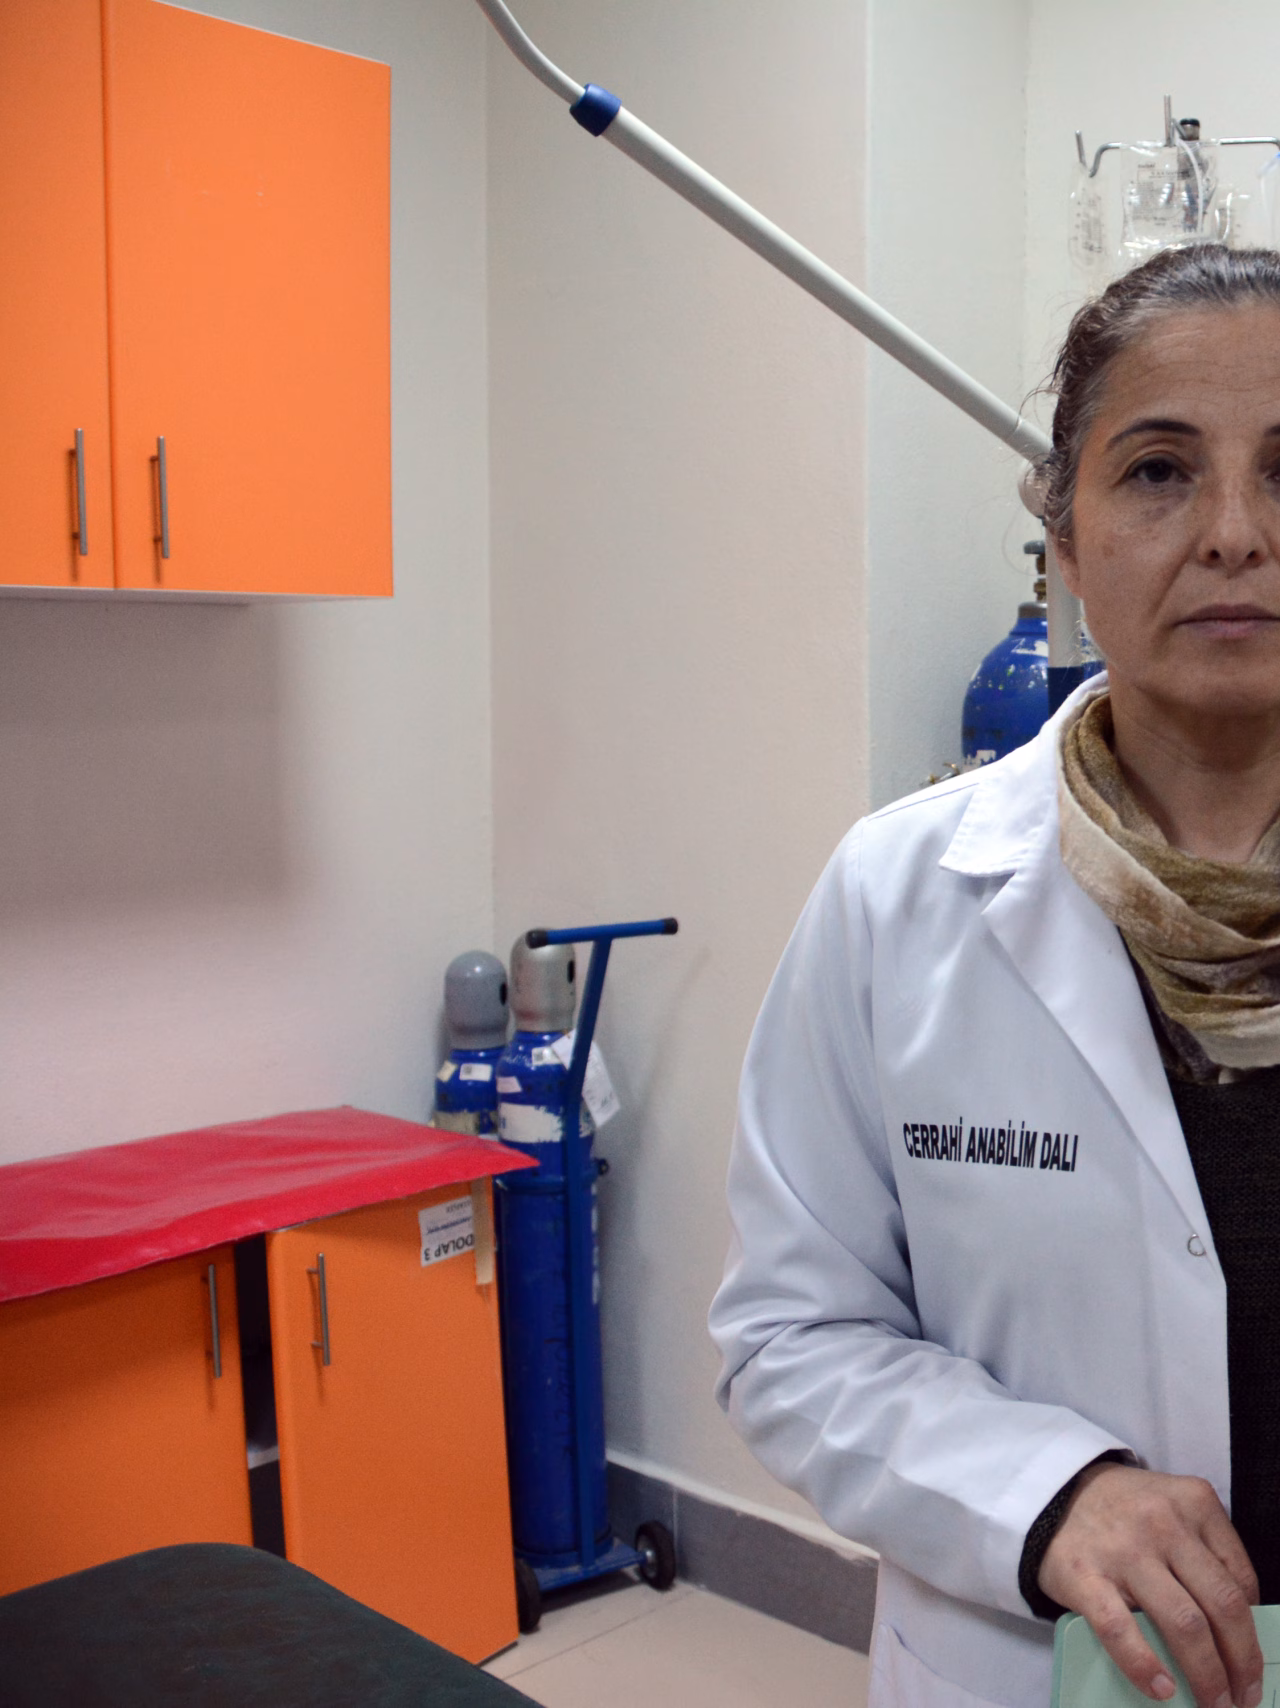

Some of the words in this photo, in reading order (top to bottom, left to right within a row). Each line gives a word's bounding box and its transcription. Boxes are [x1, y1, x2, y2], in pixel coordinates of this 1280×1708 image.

[903, 1116, 963, 1162] CERRAHİ
[965, 1119, 1038, 1169] ANABİLİM
[1039, 1132, 1079, 1172] DALI
[434, 1234, 474, 1257] DOLAP
